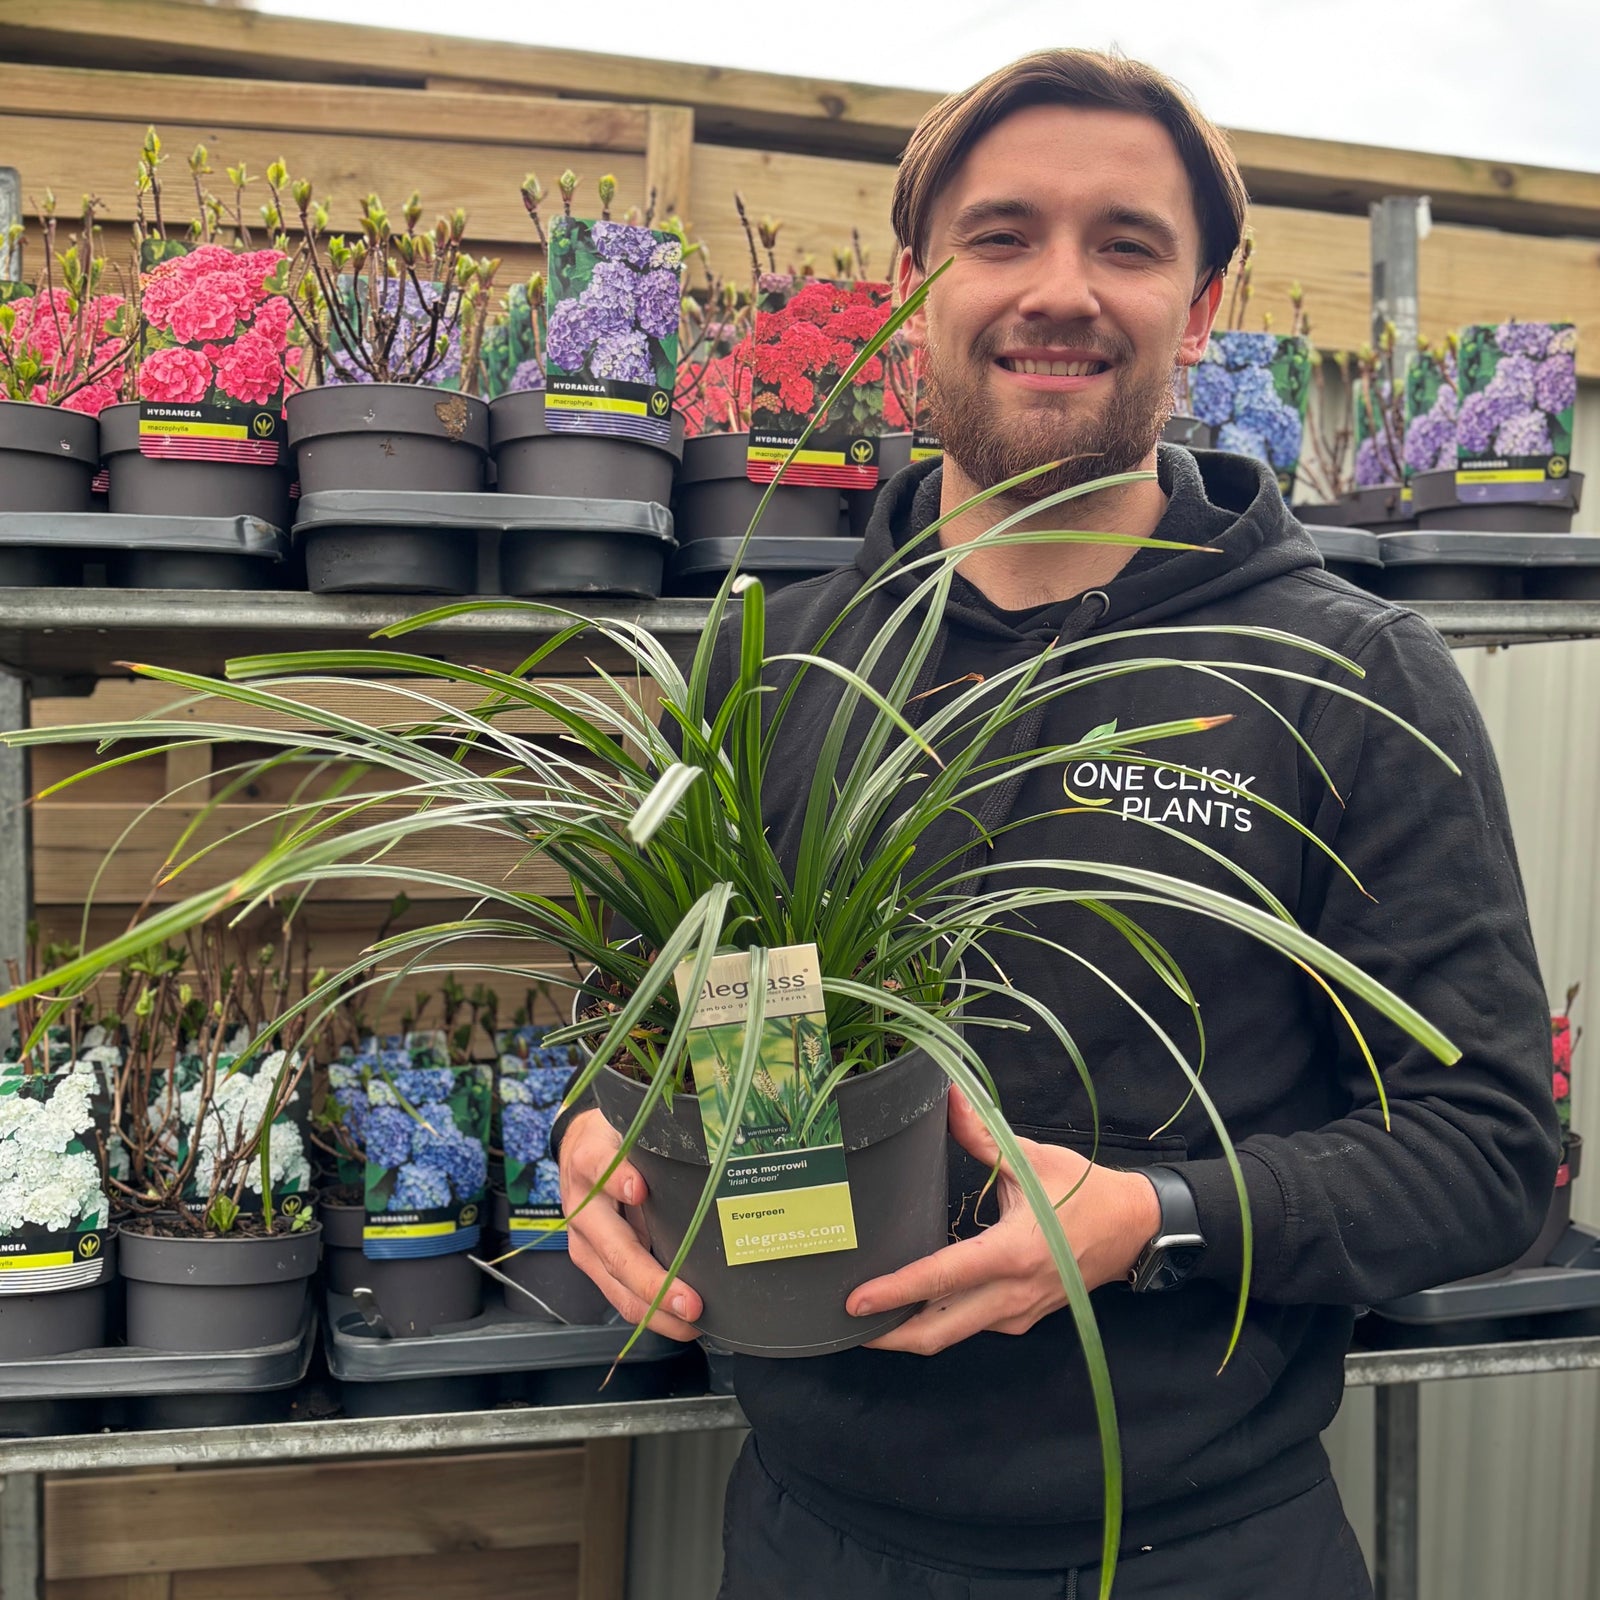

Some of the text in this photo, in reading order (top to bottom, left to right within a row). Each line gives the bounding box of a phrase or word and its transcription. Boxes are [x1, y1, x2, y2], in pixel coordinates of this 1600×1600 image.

[553, 382, 606, 393] HYDRANGEA
[553, 398, 593, 408] macrophylla
[147, 408, 202, 418] HYDRANGEA
[147, 424, 189, 433] macrophylla
[755, 436, 799, 445] HYDRANGE
[1073, 762, 1256, 801] ONE CLICK
[1122, 797, 1252, 832] PLANTS
[700, 974, 805, 1000] legass
[727, 1167, 758, 1177] Carex
[732, 1207, 785, 1220] Evergreen
[735, 1224, 846, 1247] elegrass.com
